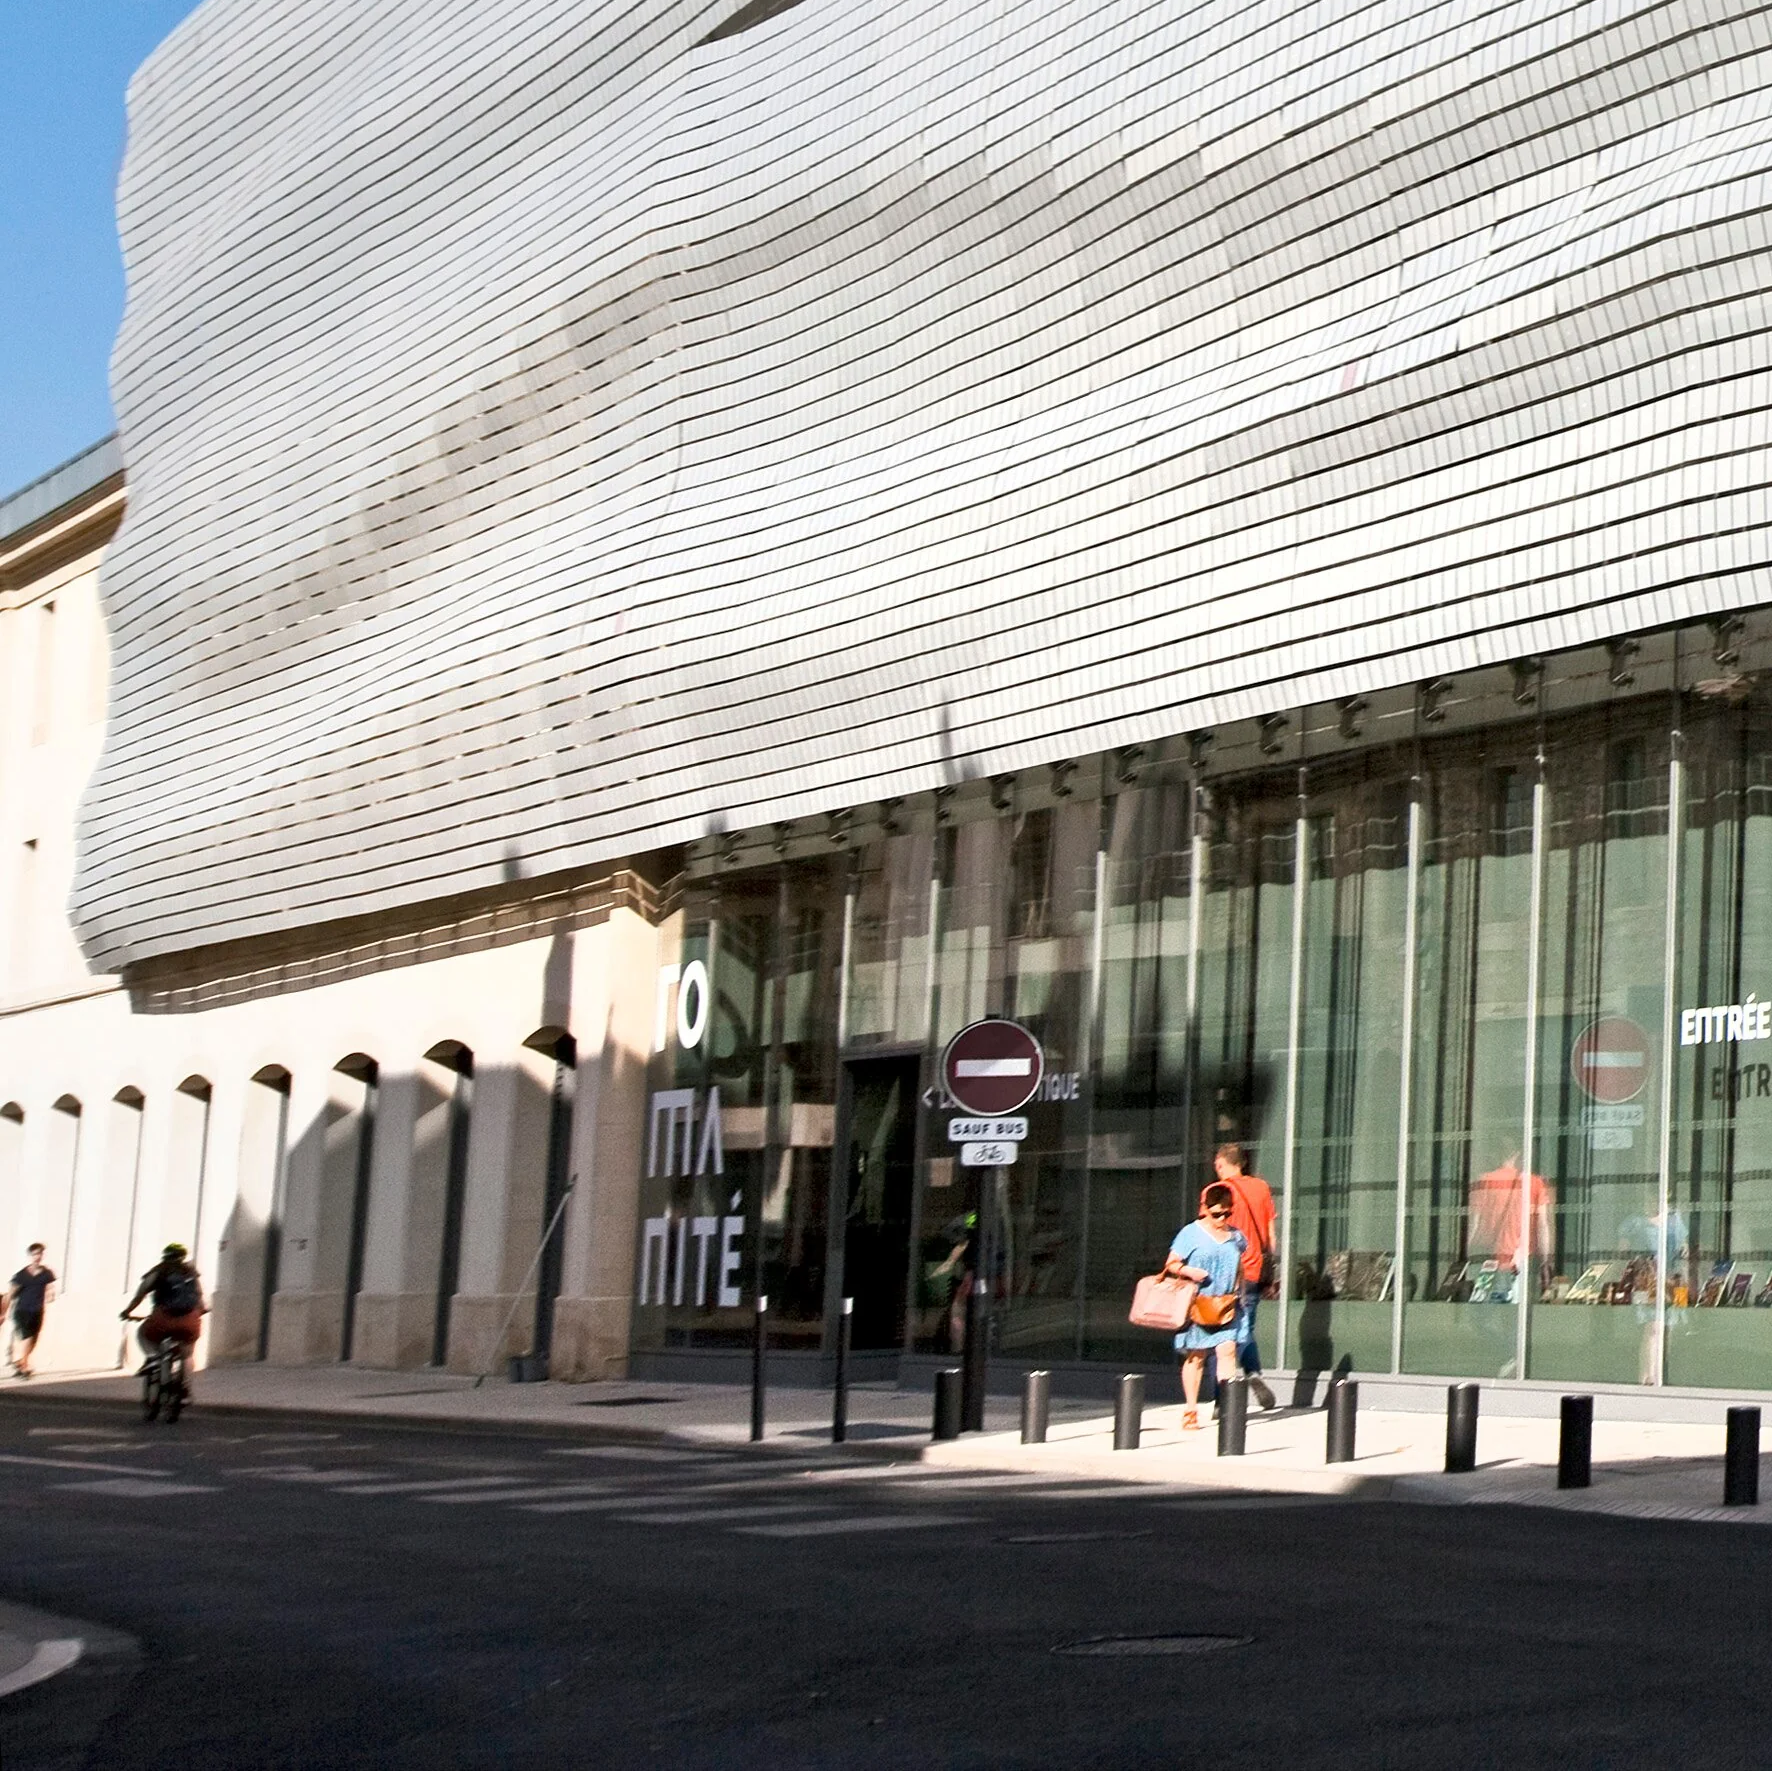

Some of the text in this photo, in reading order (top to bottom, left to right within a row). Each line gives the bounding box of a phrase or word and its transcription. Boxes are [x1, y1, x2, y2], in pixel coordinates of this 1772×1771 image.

[1680, 992, 1772, 1046] ENTRÉE
[1030, 1072, 1081, 1102] TIQUE
[951, 1122, 1025, 1136] SAUF BUS
